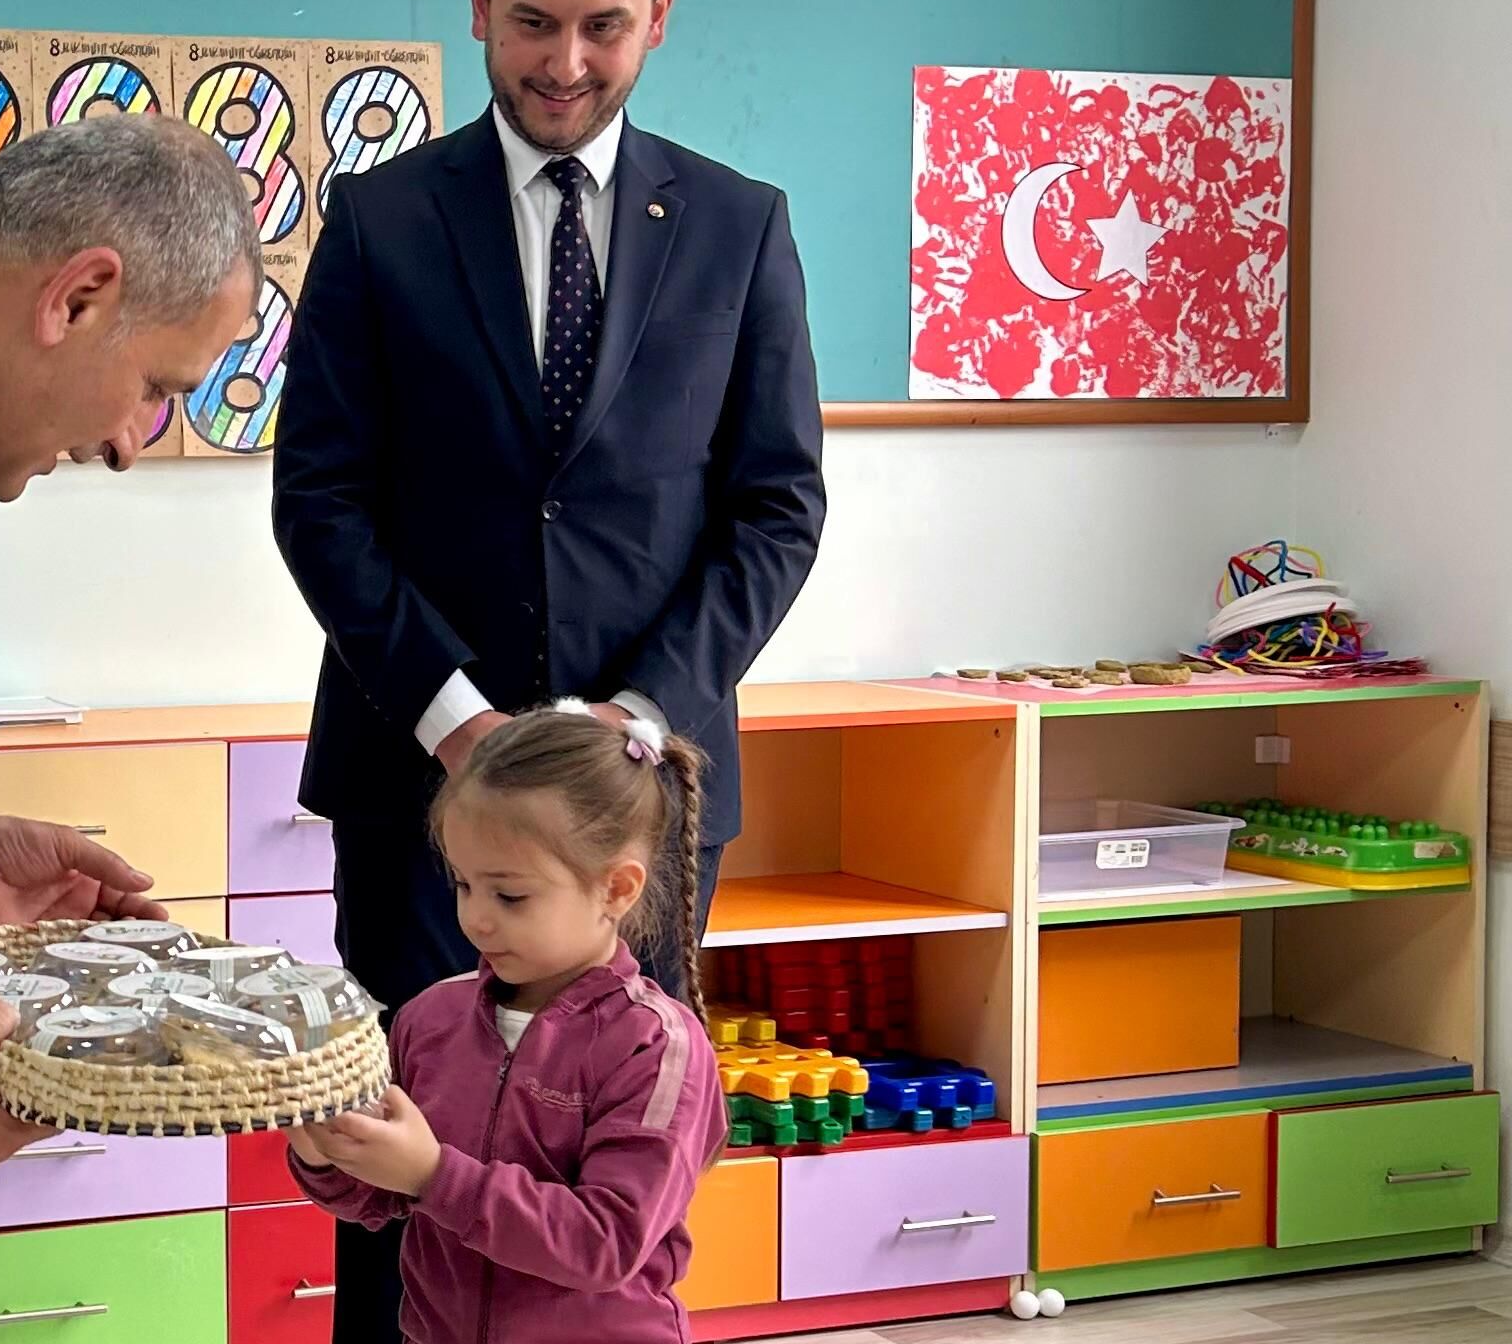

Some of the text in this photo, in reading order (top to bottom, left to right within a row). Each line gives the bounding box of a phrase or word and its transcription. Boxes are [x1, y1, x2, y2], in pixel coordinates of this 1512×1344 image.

[50, 38, 59, 56] 8
[189, 43, 199, 61] 8
[325, 46, 335, 64] 8
